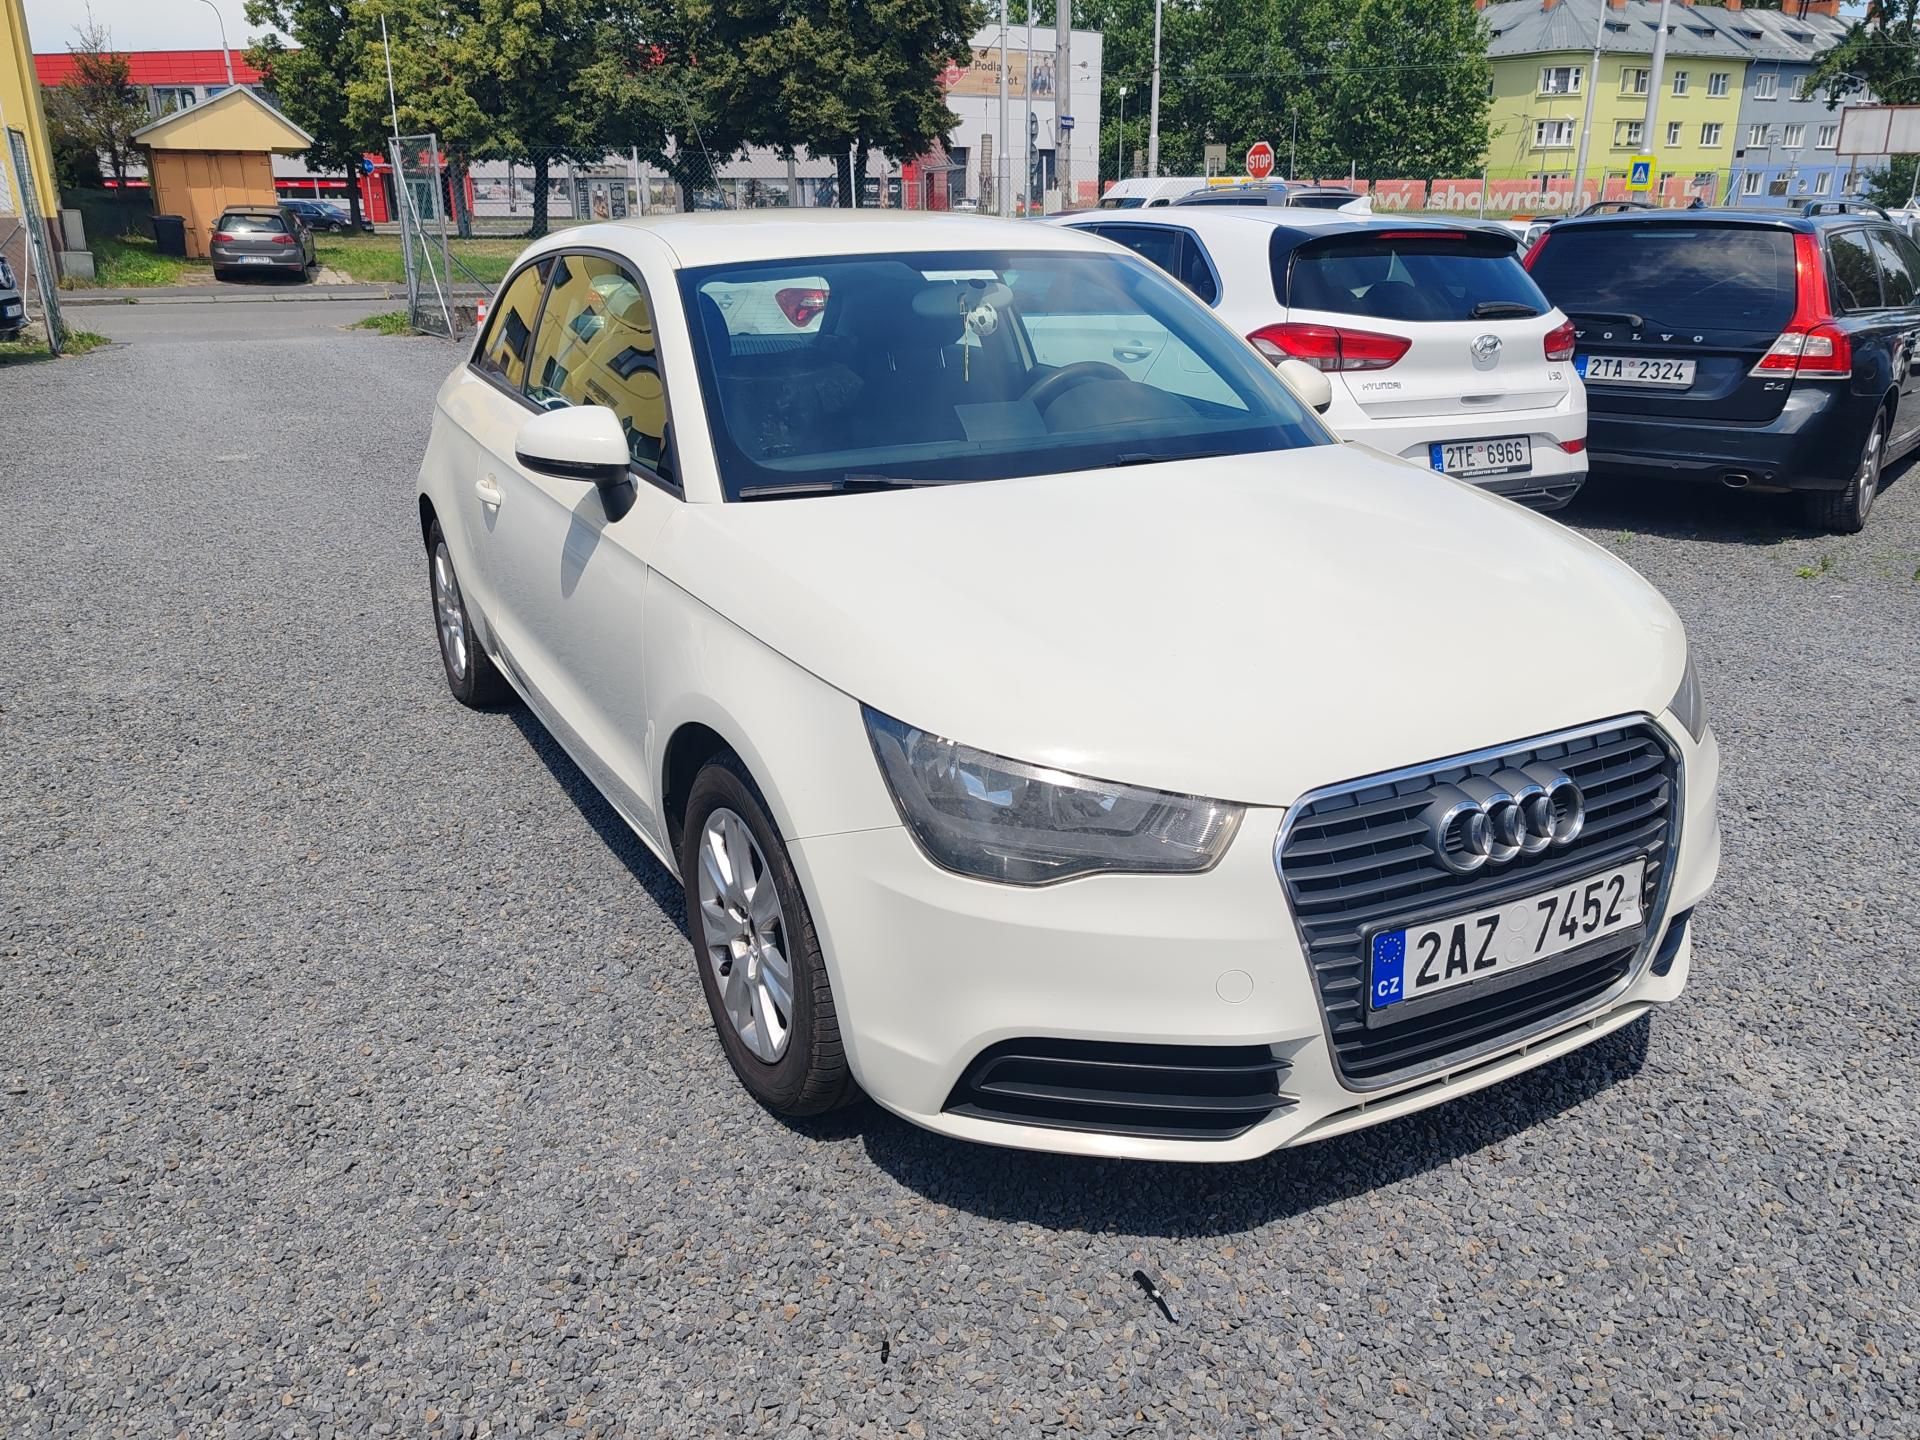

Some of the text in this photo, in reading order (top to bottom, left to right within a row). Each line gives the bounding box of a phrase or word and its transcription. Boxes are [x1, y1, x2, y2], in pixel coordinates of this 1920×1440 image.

[975, 60, 1013, 75] Podlay
[1249, 153, 1271, 170] STOP
[1428, 183, 1592, 209] showroom
[1574, 329, 1704, 344] VOLVO
[1547, 370, 1562, 381] i30
[1589, 358, 1684, 381] 2TA 2324
[1361, 381, 1402, 392] HYUNDAI
[1446, 441, 1523, 469] 2TE 6966
[1415, 874, 1626, 989] 2AZ 7452
[1377, 976, 1400, 996] CZ
